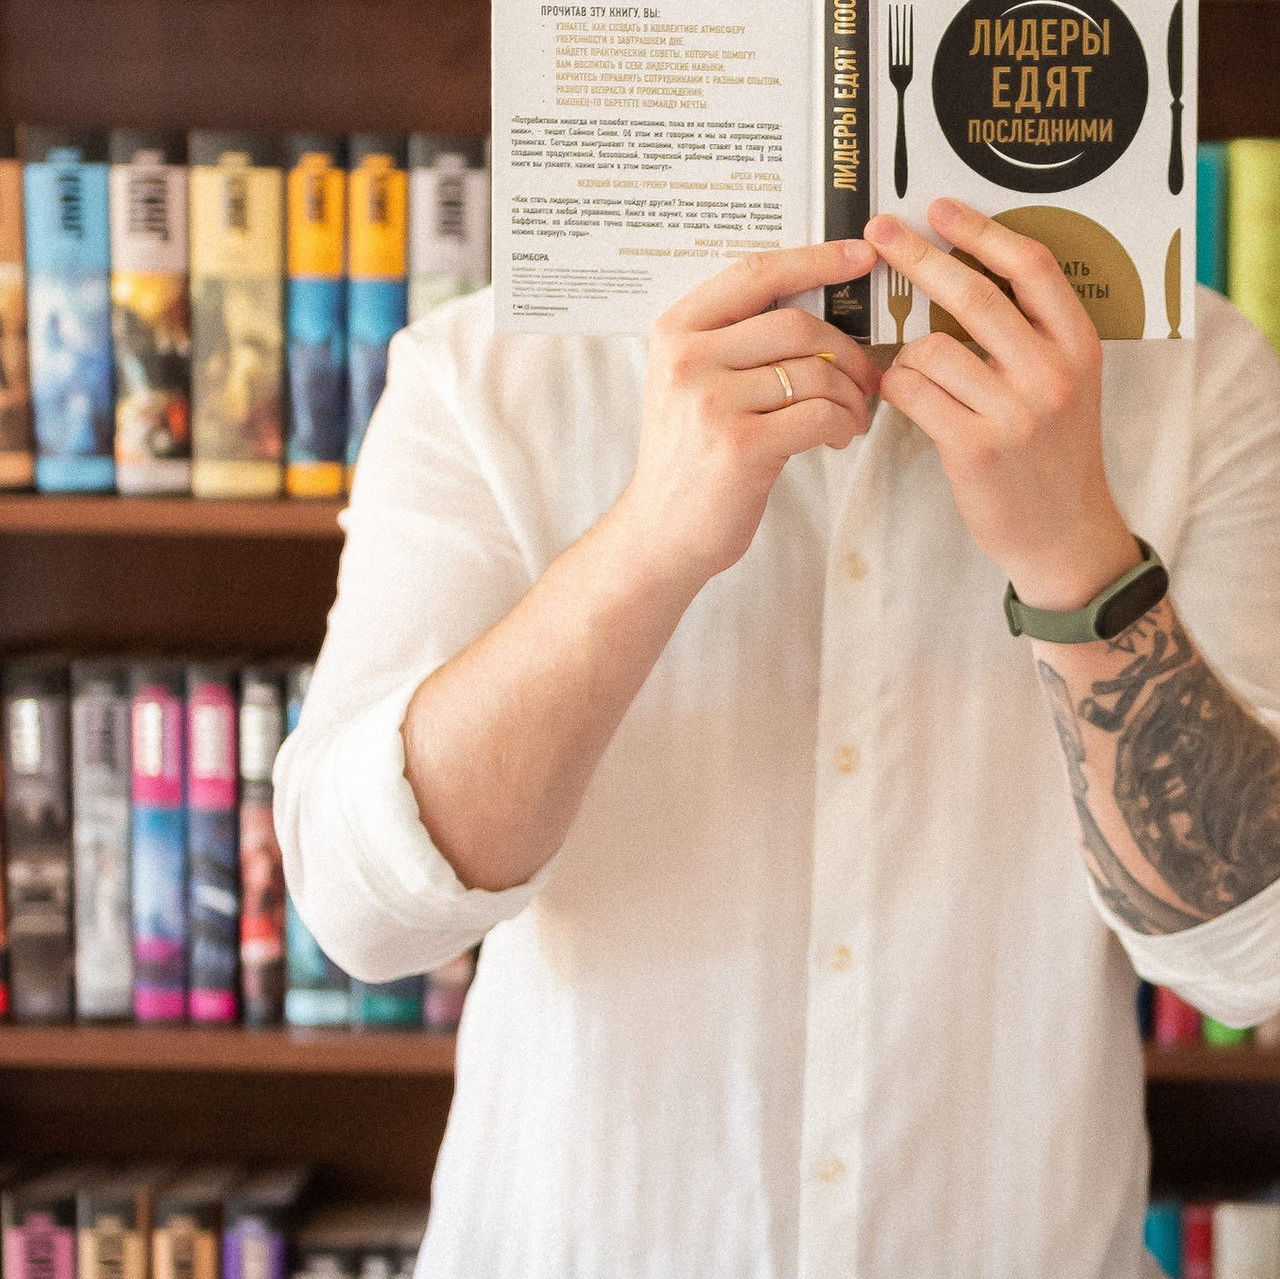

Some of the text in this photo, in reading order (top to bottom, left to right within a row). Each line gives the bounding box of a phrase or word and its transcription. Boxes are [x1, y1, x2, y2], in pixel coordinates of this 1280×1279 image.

[540, 5, 587, 16] ПРОЧИТАВ
[590, 6, 606, 17] ЭТУ
[643, 7, 660, 18] ВЫ:
[969, 18, 1110, 61] ЛИДЕРЫ
[834, 47, 860, 98] ЕДЯТ
[992, 65, 1092, 113] ЕДЯТ
[833, 108, 860, 191] ЛИДЕРЫ
[968, 118, 1114, 146] ПОСЛЕДНИМИ
[512, 252, 550, 262] БОМБОРА
[1071, 283, 1109, 299] ЧТЫ
